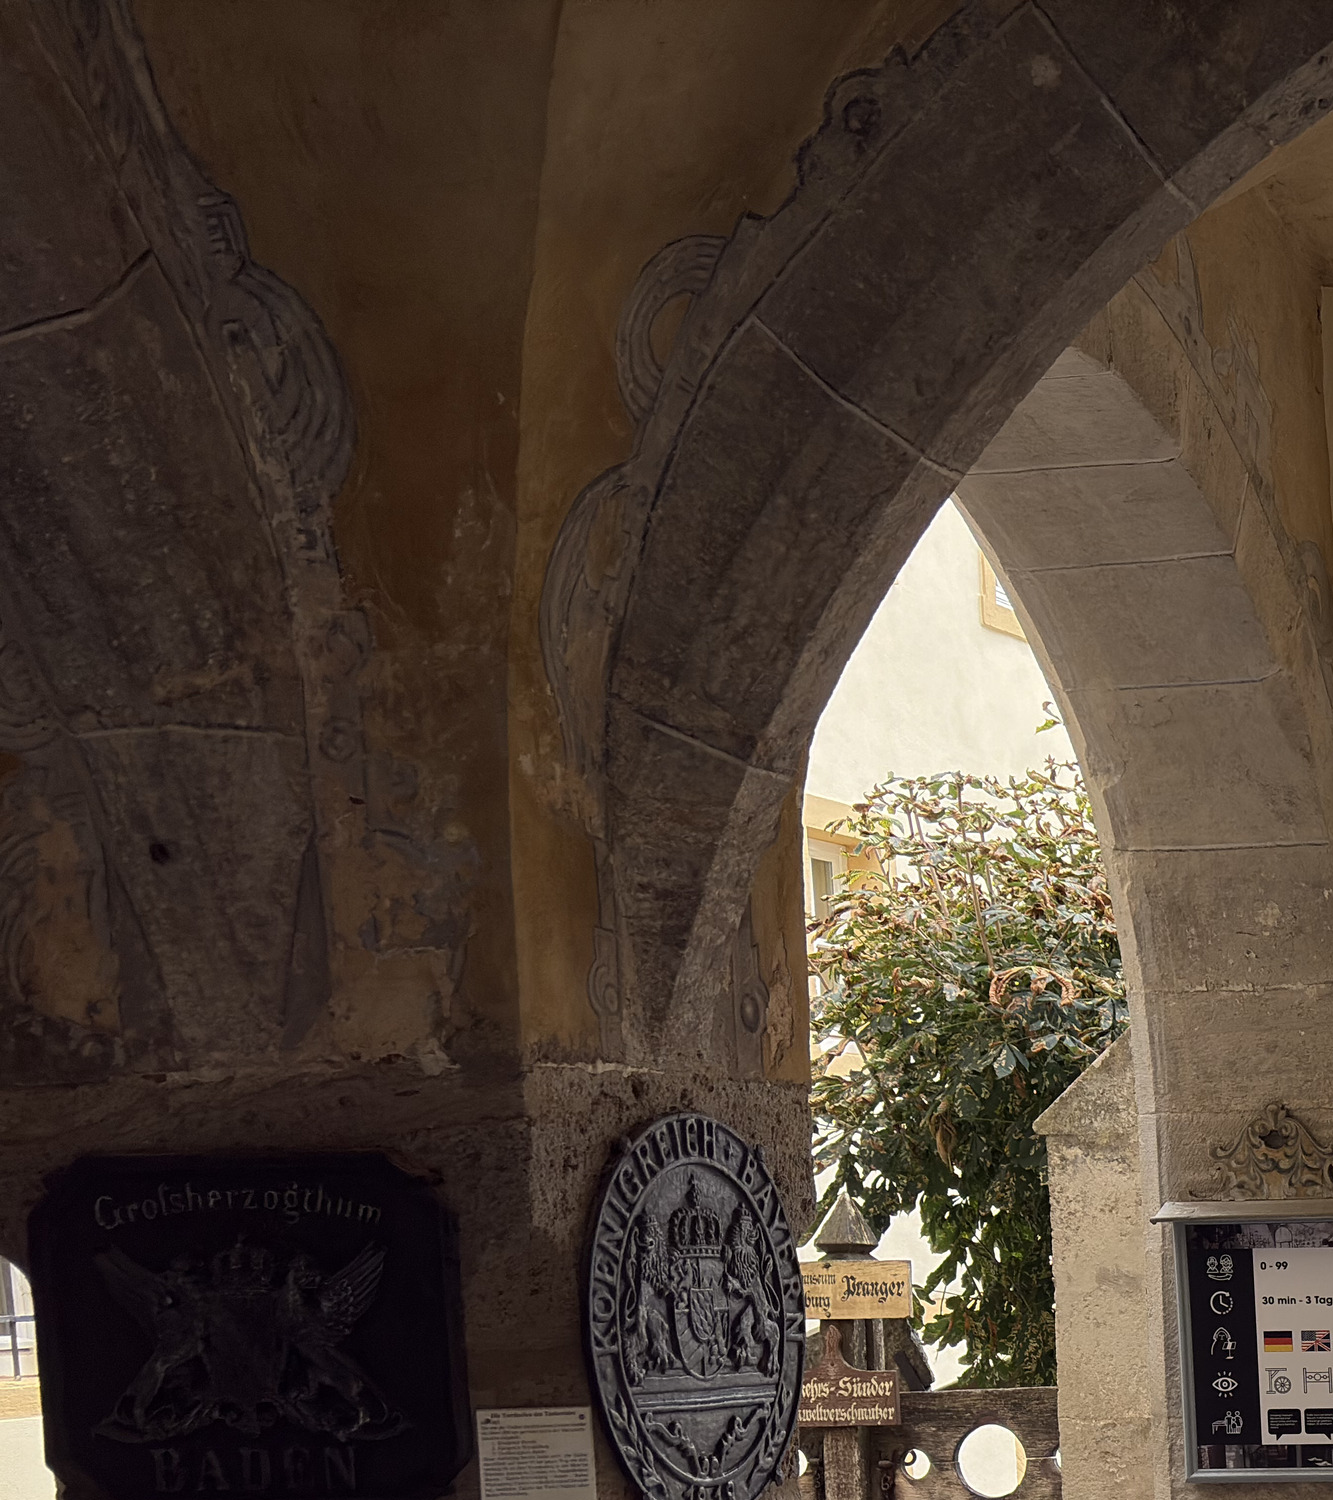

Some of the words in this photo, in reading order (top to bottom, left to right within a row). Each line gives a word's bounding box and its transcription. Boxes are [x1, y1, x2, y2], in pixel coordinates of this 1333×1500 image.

[592, 1118, 718, 1357] KOENIGREICH
[740, 1153, 806, 1342] BAYERN
[1260, 1261, 1267, 1271] 0
[1275, 1261, 1289, 1271] 99
[841, 1275, 905, 1303] Pranger
[1262, 1296, 1275, 1305] 30
[1277, 1295, 1297, 1305] min
[1306, 1295, 1312, 1305] 3
[152, 1444, 359, 1494] BADEN
